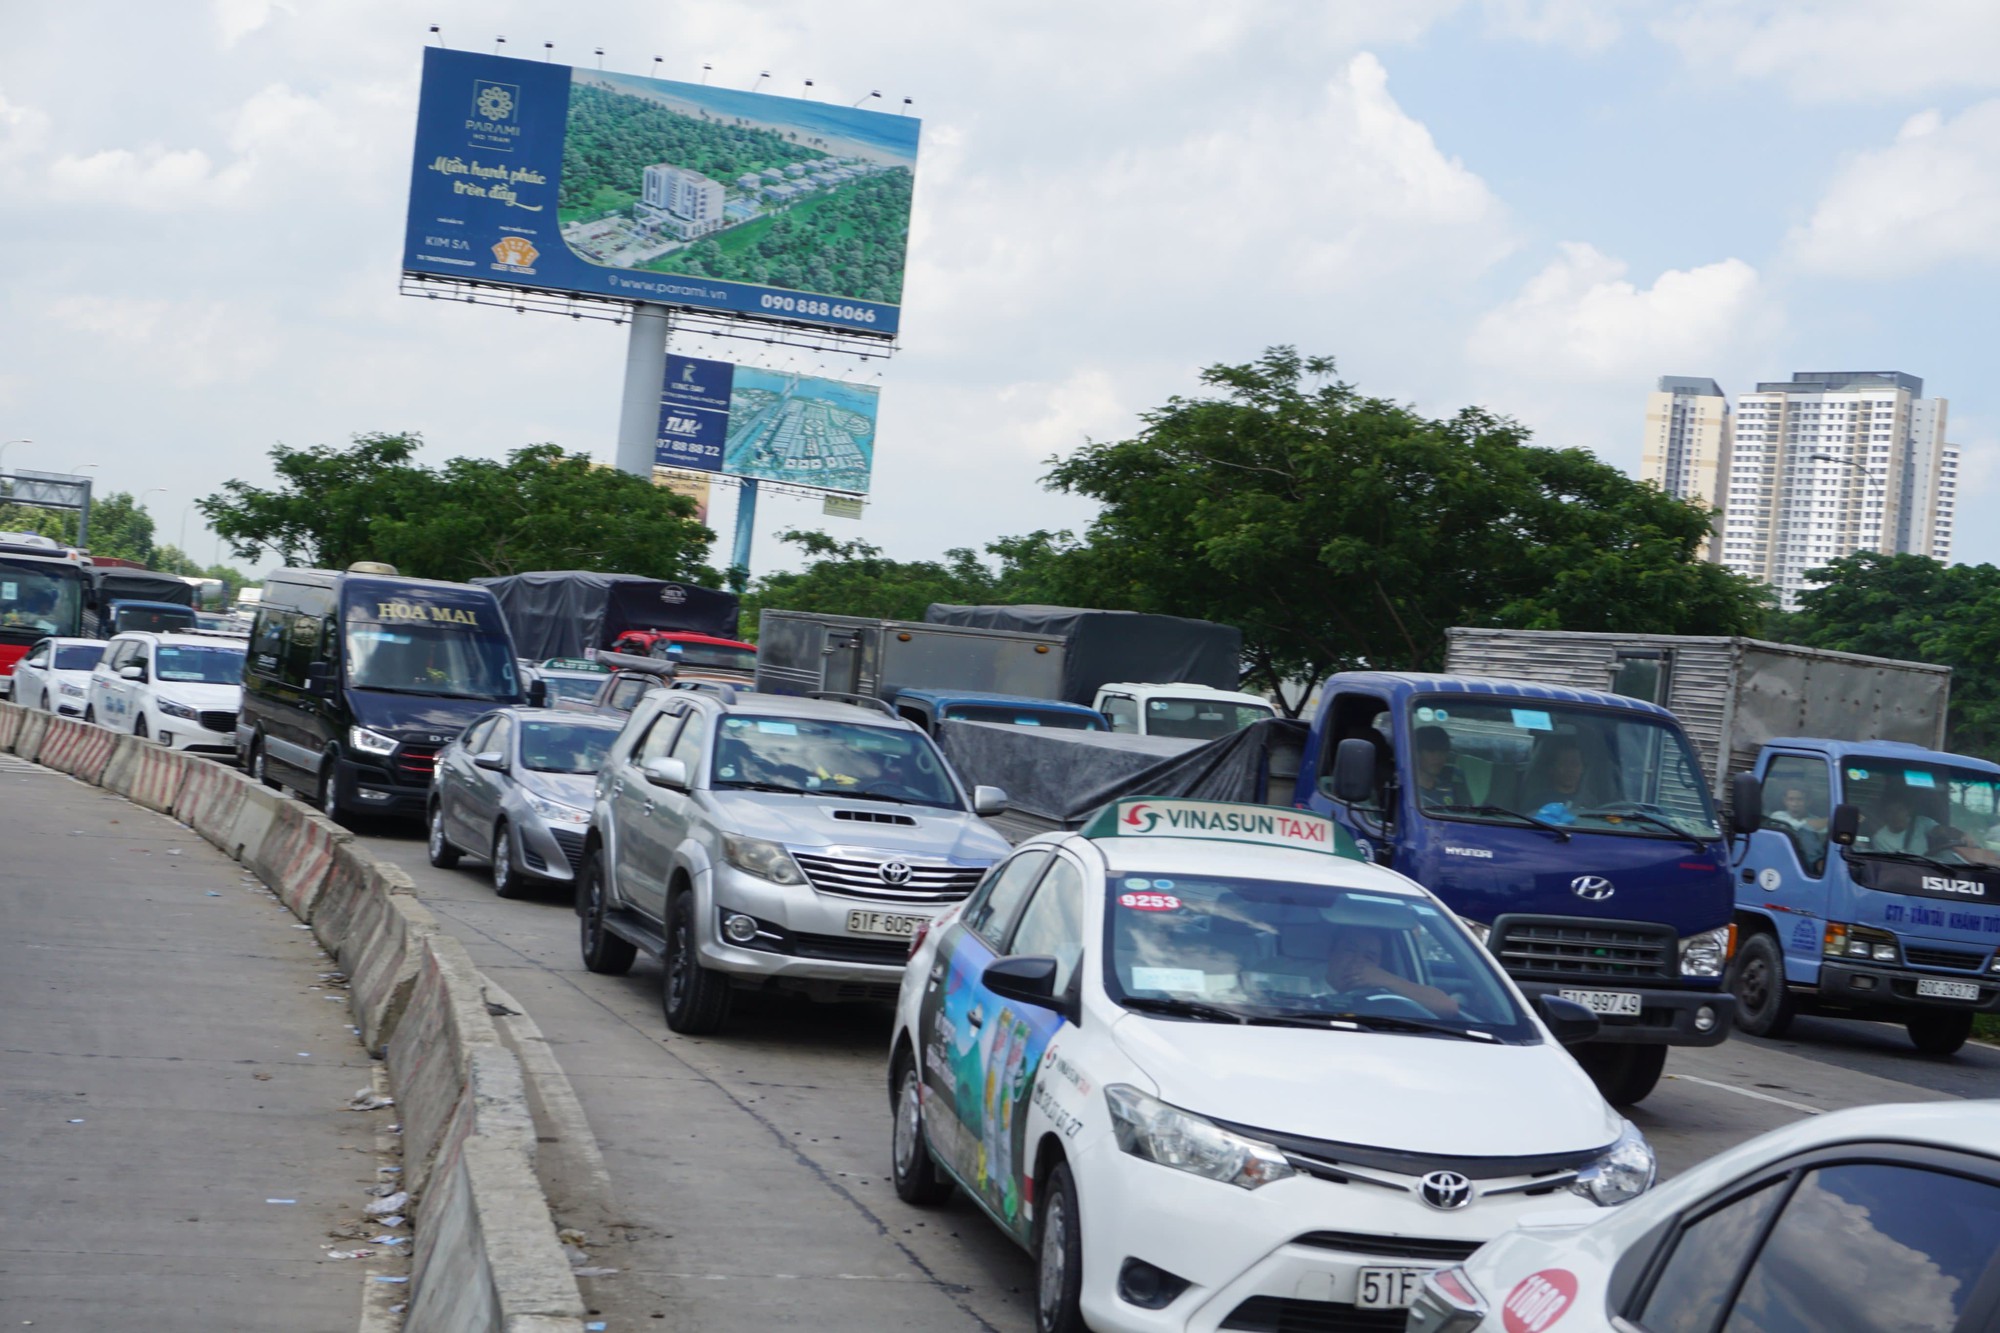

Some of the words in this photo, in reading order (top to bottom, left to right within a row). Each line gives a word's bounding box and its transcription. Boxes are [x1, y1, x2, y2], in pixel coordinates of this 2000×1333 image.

[465, 120, 520, 137] PARAMI
[471, 160, 509, 180] hạnh
[510, 167, 547, 185] phúc
[425, 235, 450, 248] KIM
[620, 279, 728, 300] www.parami.vn
[761, 294, 795, 312] 090
[796, 299, 830, 316] 888
[831, 304, 876, 323] 6066
[704, 445, 720, 457] 22
[377, 603, 429, 620] HOA
[430, 606, 479, 626] MAI
[1166, 808, 1274, 835] VINASUN
[1277, 816, 1325, 842] TAXI
[1445, 846, 1493, 859] HYUNDAI
[1921, 876, 1984, 896] ISUZU
[1121, 894, 1179, 908] 9253
[850, 911, 931, 934] 51F-605
[1362, 1271, 1417, 1305] 51F
[1506, 1274, 1567, 1332] 11608
